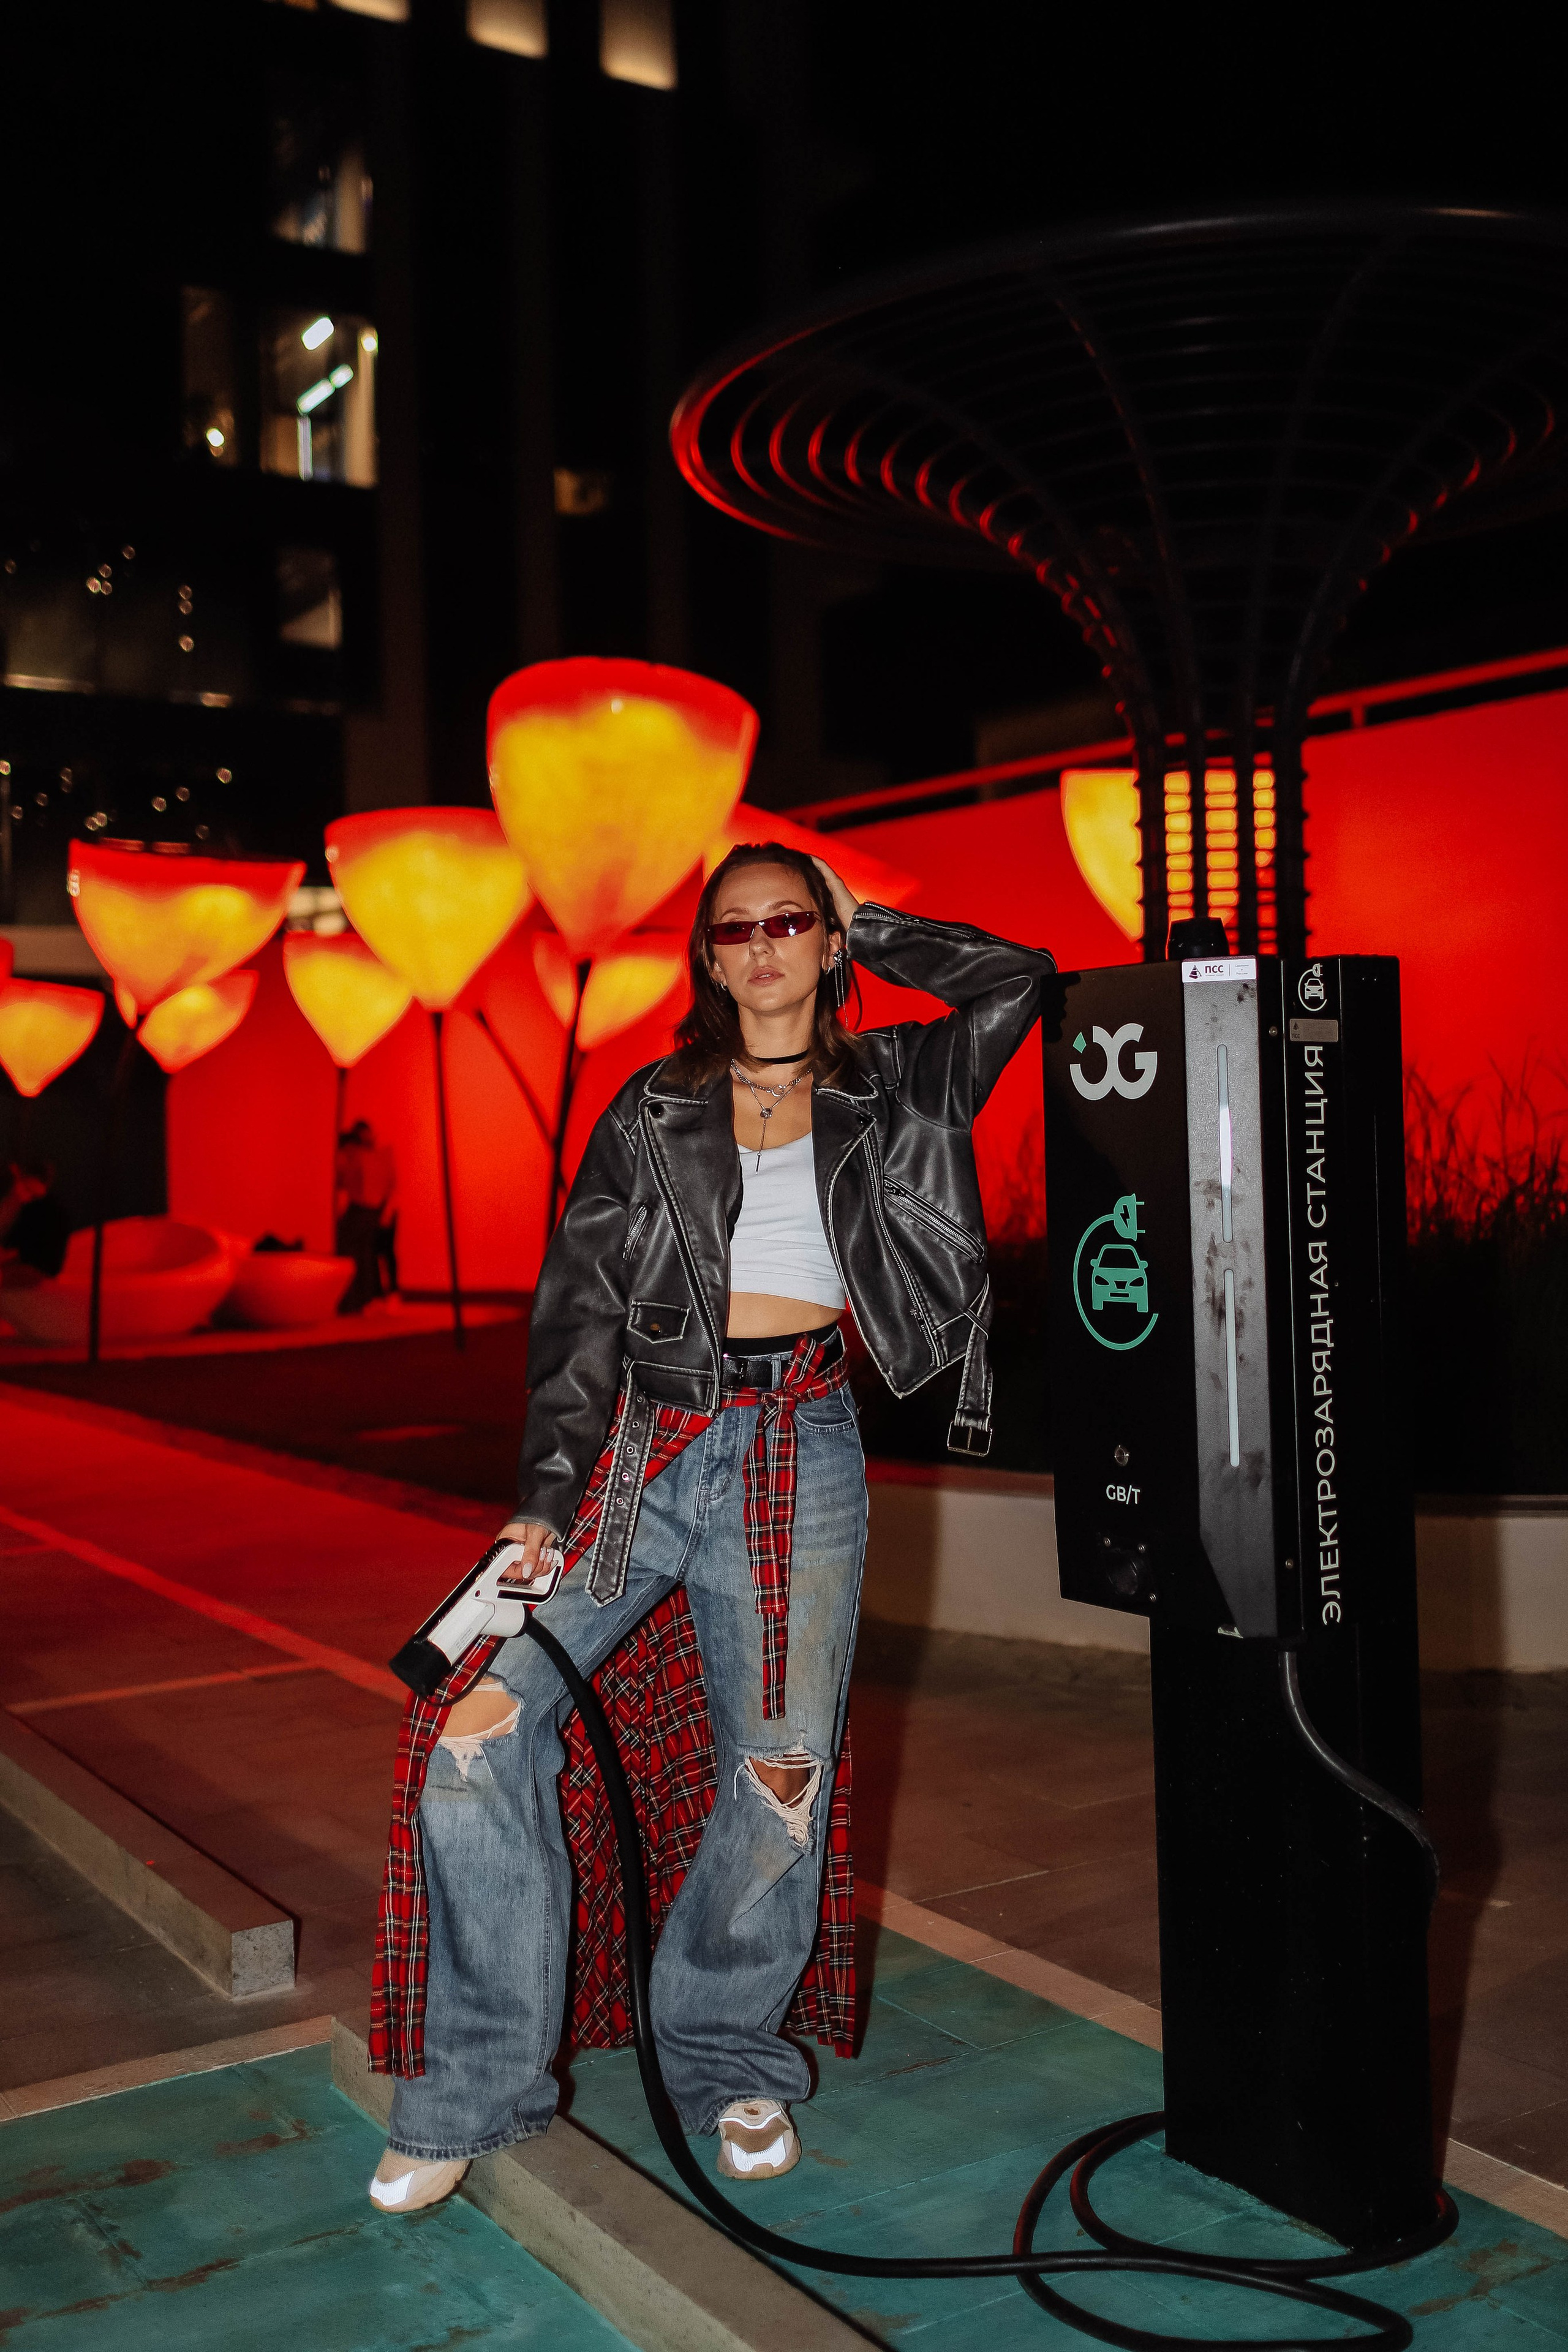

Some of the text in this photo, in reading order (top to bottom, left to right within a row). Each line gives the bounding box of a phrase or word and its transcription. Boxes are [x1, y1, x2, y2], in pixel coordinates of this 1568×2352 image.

[1205, 965, 1224, 974] ПСС
[1304, 1046, 1341, 1626] ЭЛЕКТРОЗАРЯДНАЯ СТАНЦИЯ
[1106, 1484, 1141, 1505] GB/T
